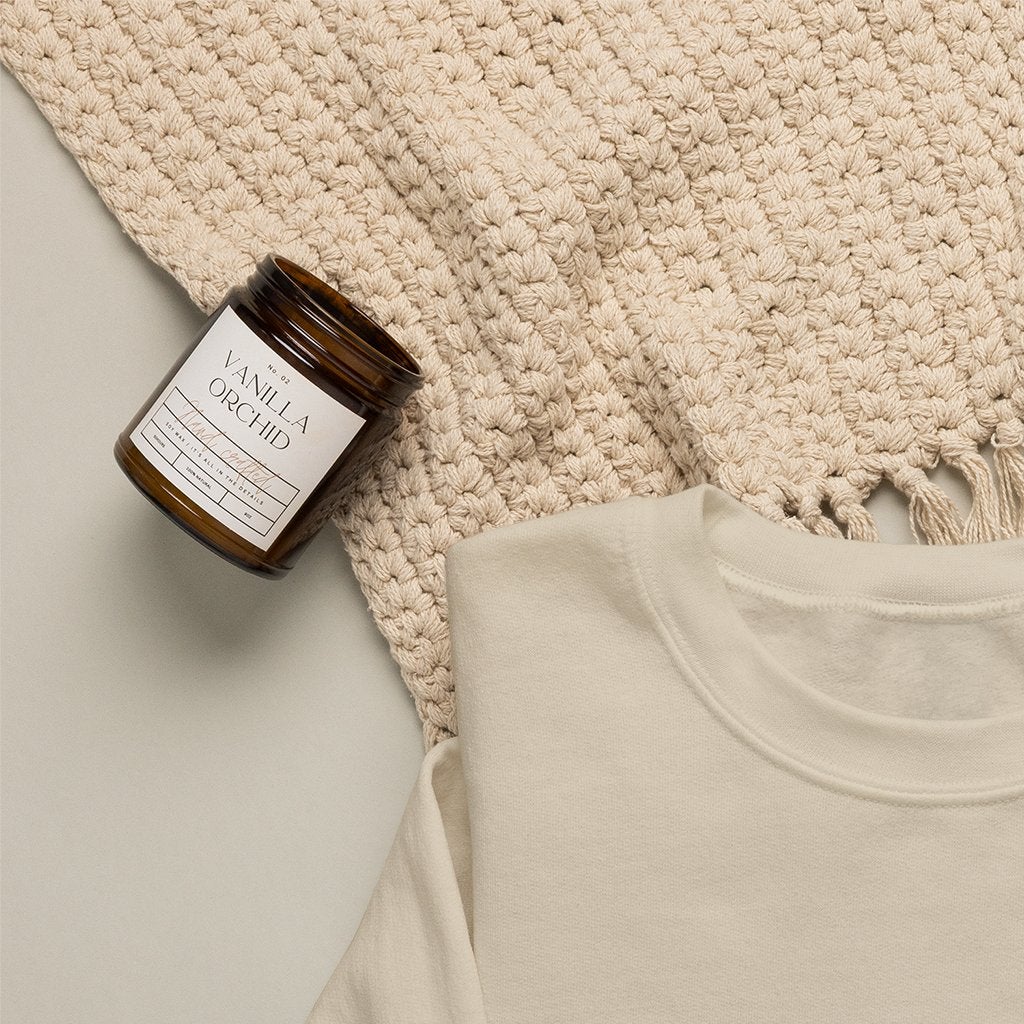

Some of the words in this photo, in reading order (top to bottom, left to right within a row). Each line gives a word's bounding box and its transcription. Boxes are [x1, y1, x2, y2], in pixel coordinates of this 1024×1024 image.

[225, 349, 309, 434] VANILLA
[266, 364, 278, 376] No.
[280, 375, 291, 385] 02
[209, 377, 290, 450] ORCHID
[203, 458, 214, 468] ALL
[215, 468, 223, 476] IN
[225, 475, 237, 486] THE
[238, 485, 264, 506] DETAILS
